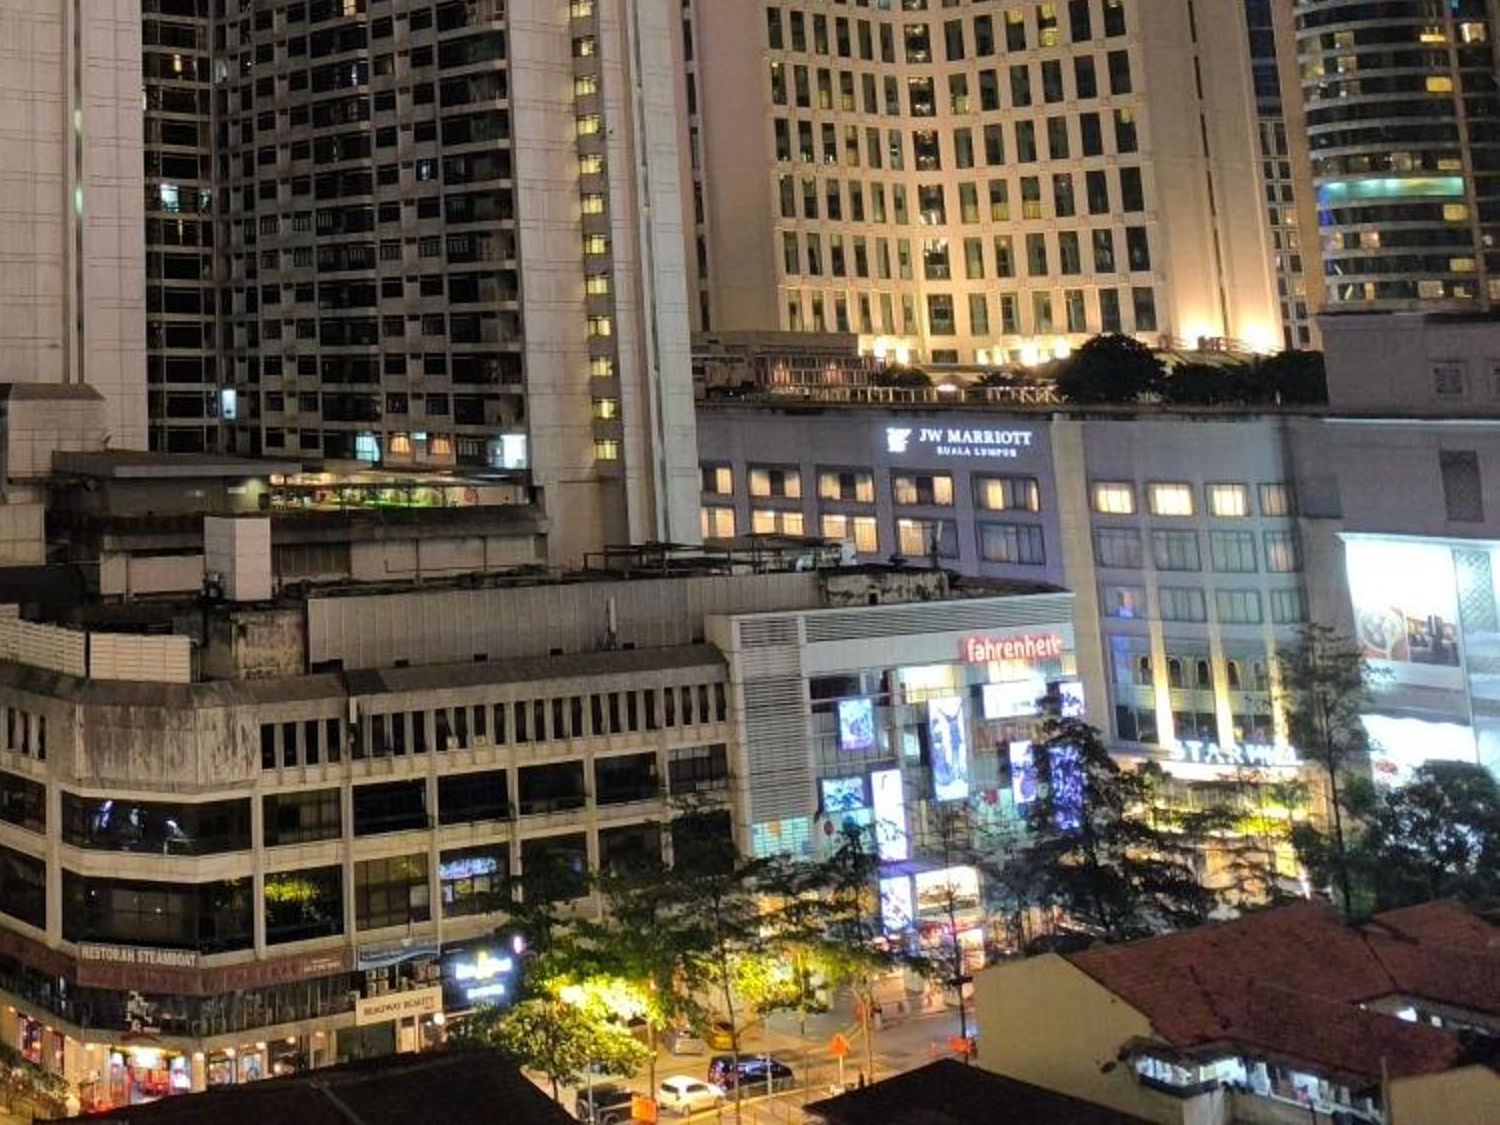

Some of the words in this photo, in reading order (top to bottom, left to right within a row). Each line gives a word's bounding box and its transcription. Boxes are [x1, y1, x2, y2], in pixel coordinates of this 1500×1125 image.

[919, 428, 943, 443] JW
[947, 429, 1032, 445] MARRIOTT
[967, 635, 1063, 662] fahrenheit
[137, 949, 197, 967] STEAMBOAT
